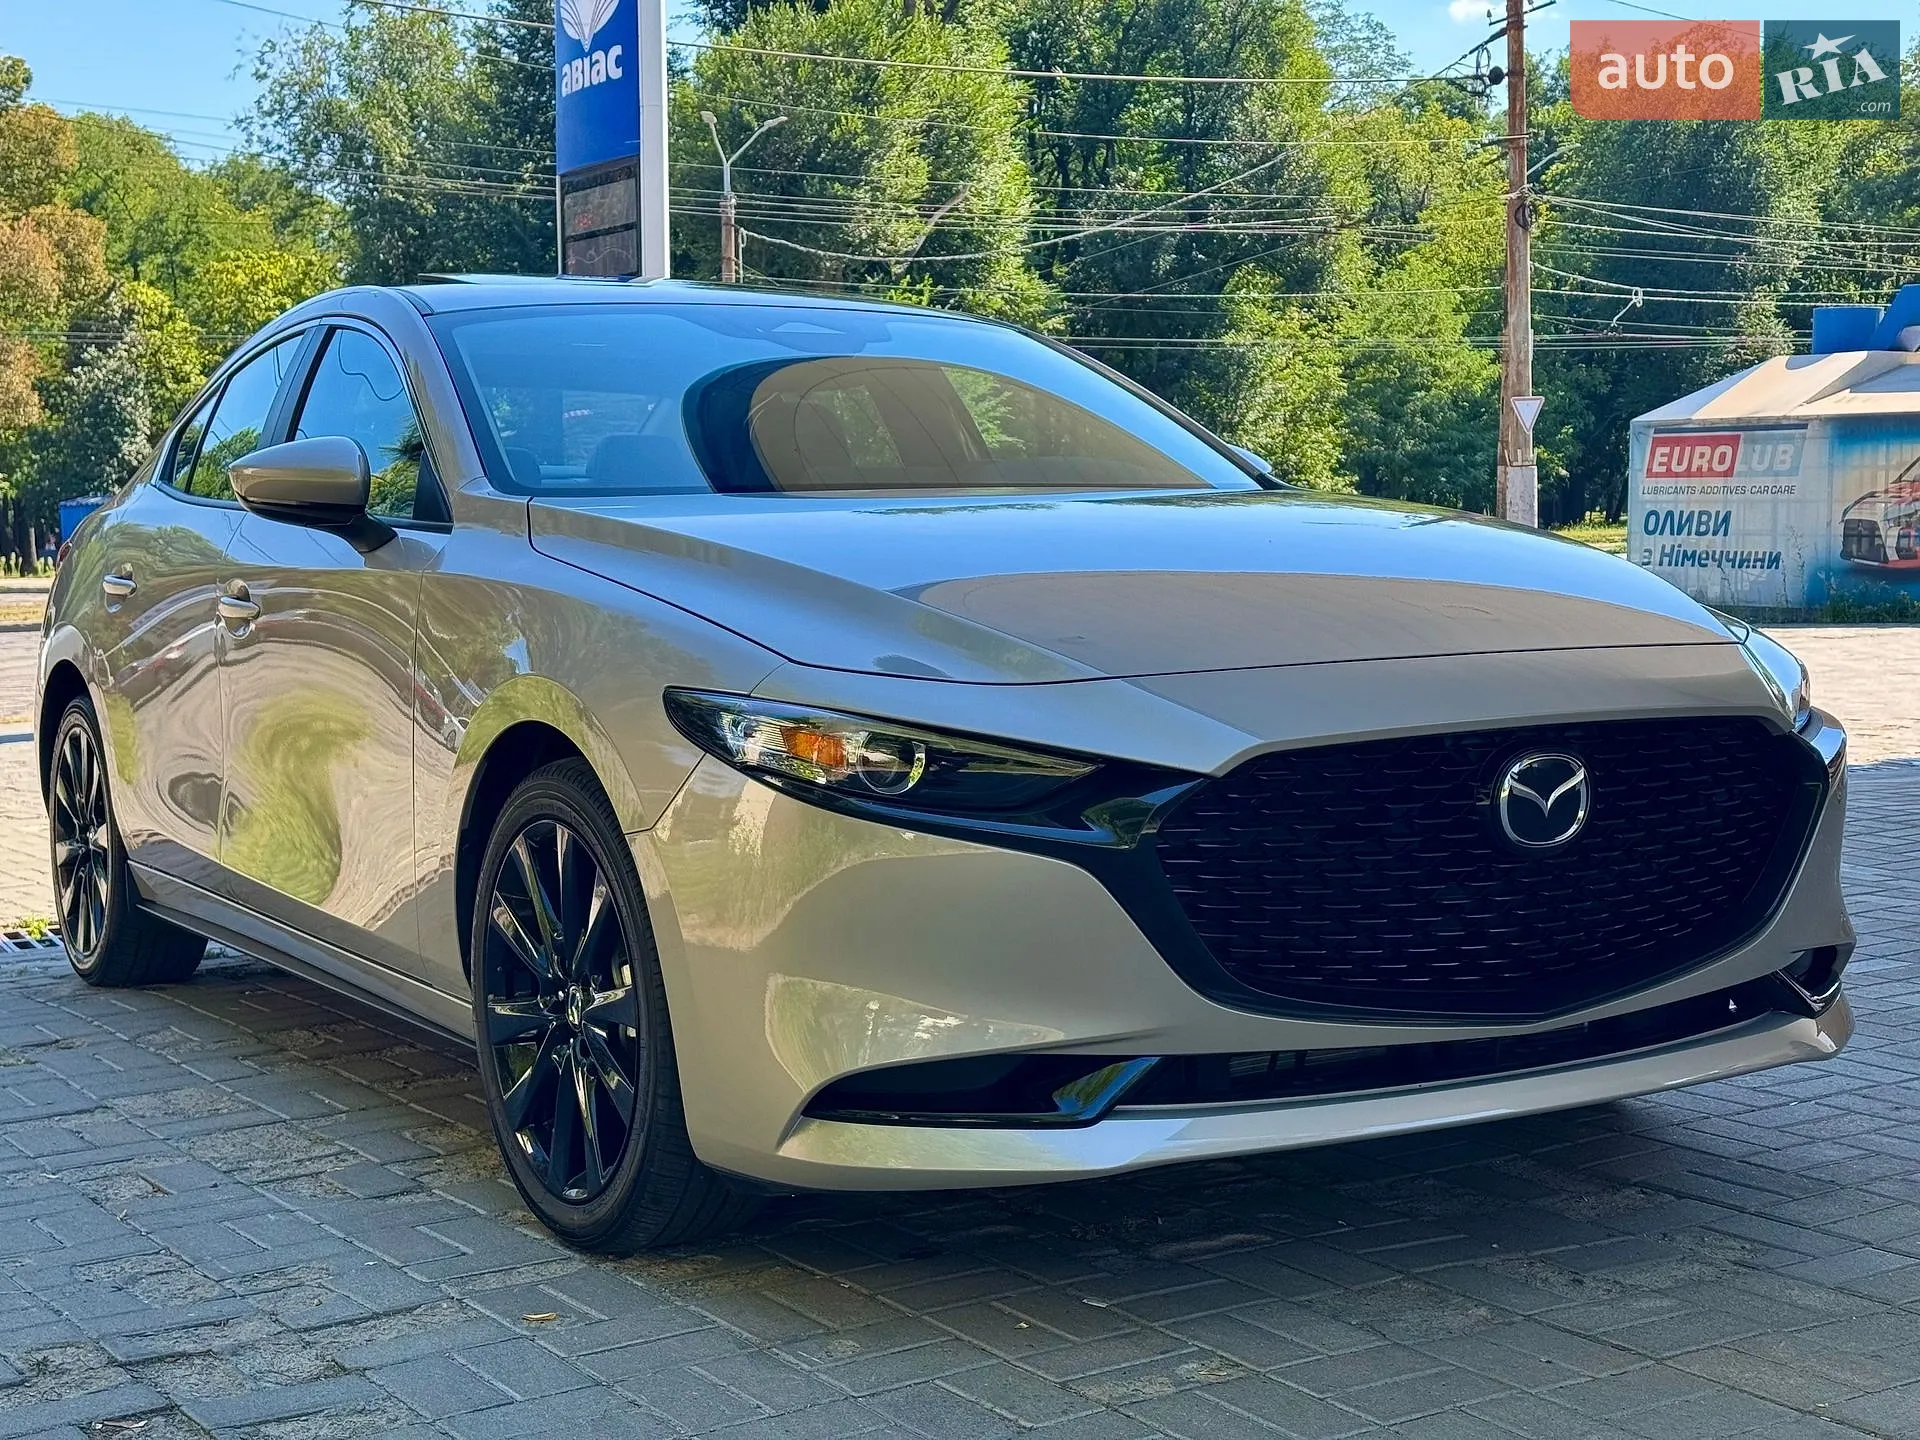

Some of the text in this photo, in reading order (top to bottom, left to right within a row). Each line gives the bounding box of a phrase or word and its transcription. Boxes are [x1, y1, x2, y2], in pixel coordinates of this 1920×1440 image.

[1643, 510, 1732, 537] ОЛИВИ
[1641, 544, 1782, 570] з Німеччини
